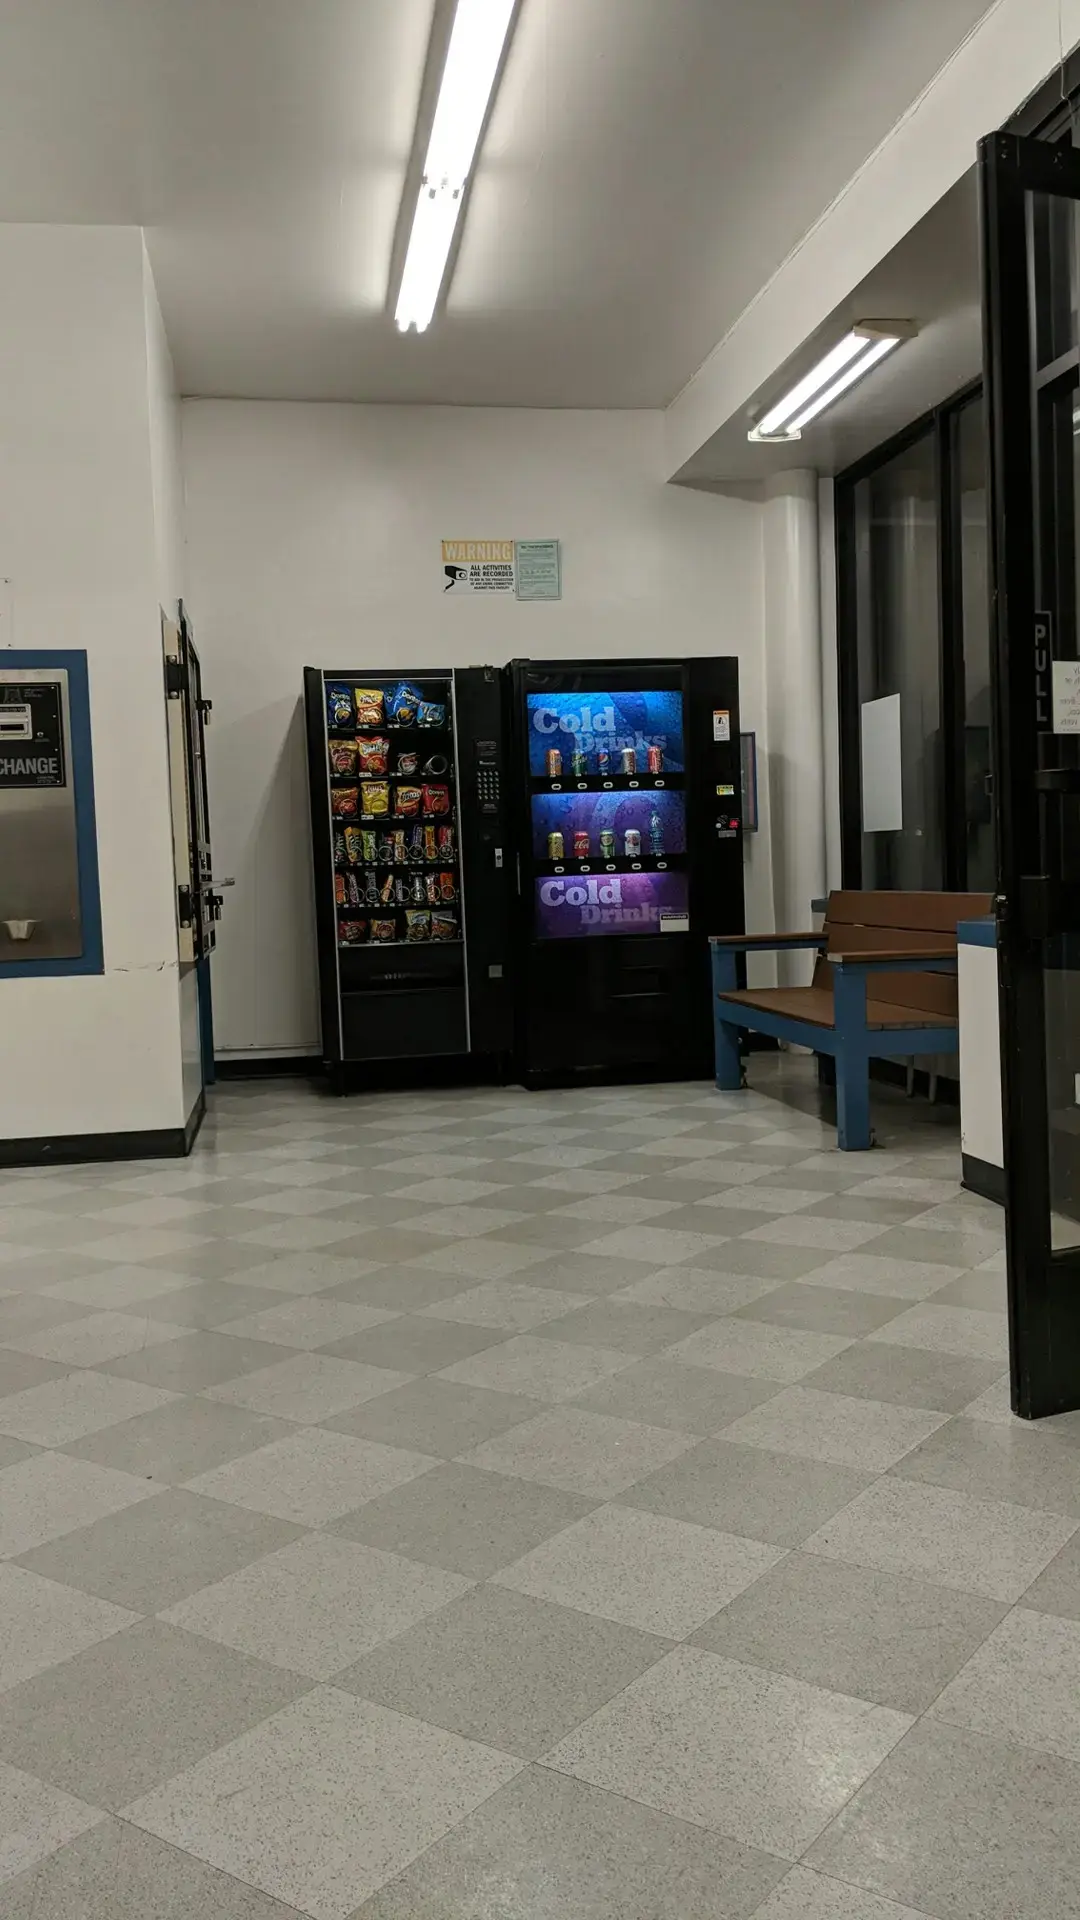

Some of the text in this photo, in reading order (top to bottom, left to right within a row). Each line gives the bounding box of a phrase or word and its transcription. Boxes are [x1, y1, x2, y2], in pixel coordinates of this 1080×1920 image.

[445, 542, 512, 560] WARNING
[1035, 624, 1048, 722] PULL
[533, 706, 616, 733] Cold
[574, 729, 668, 753] Drinks
[540, 879, 622, 906] Cold
